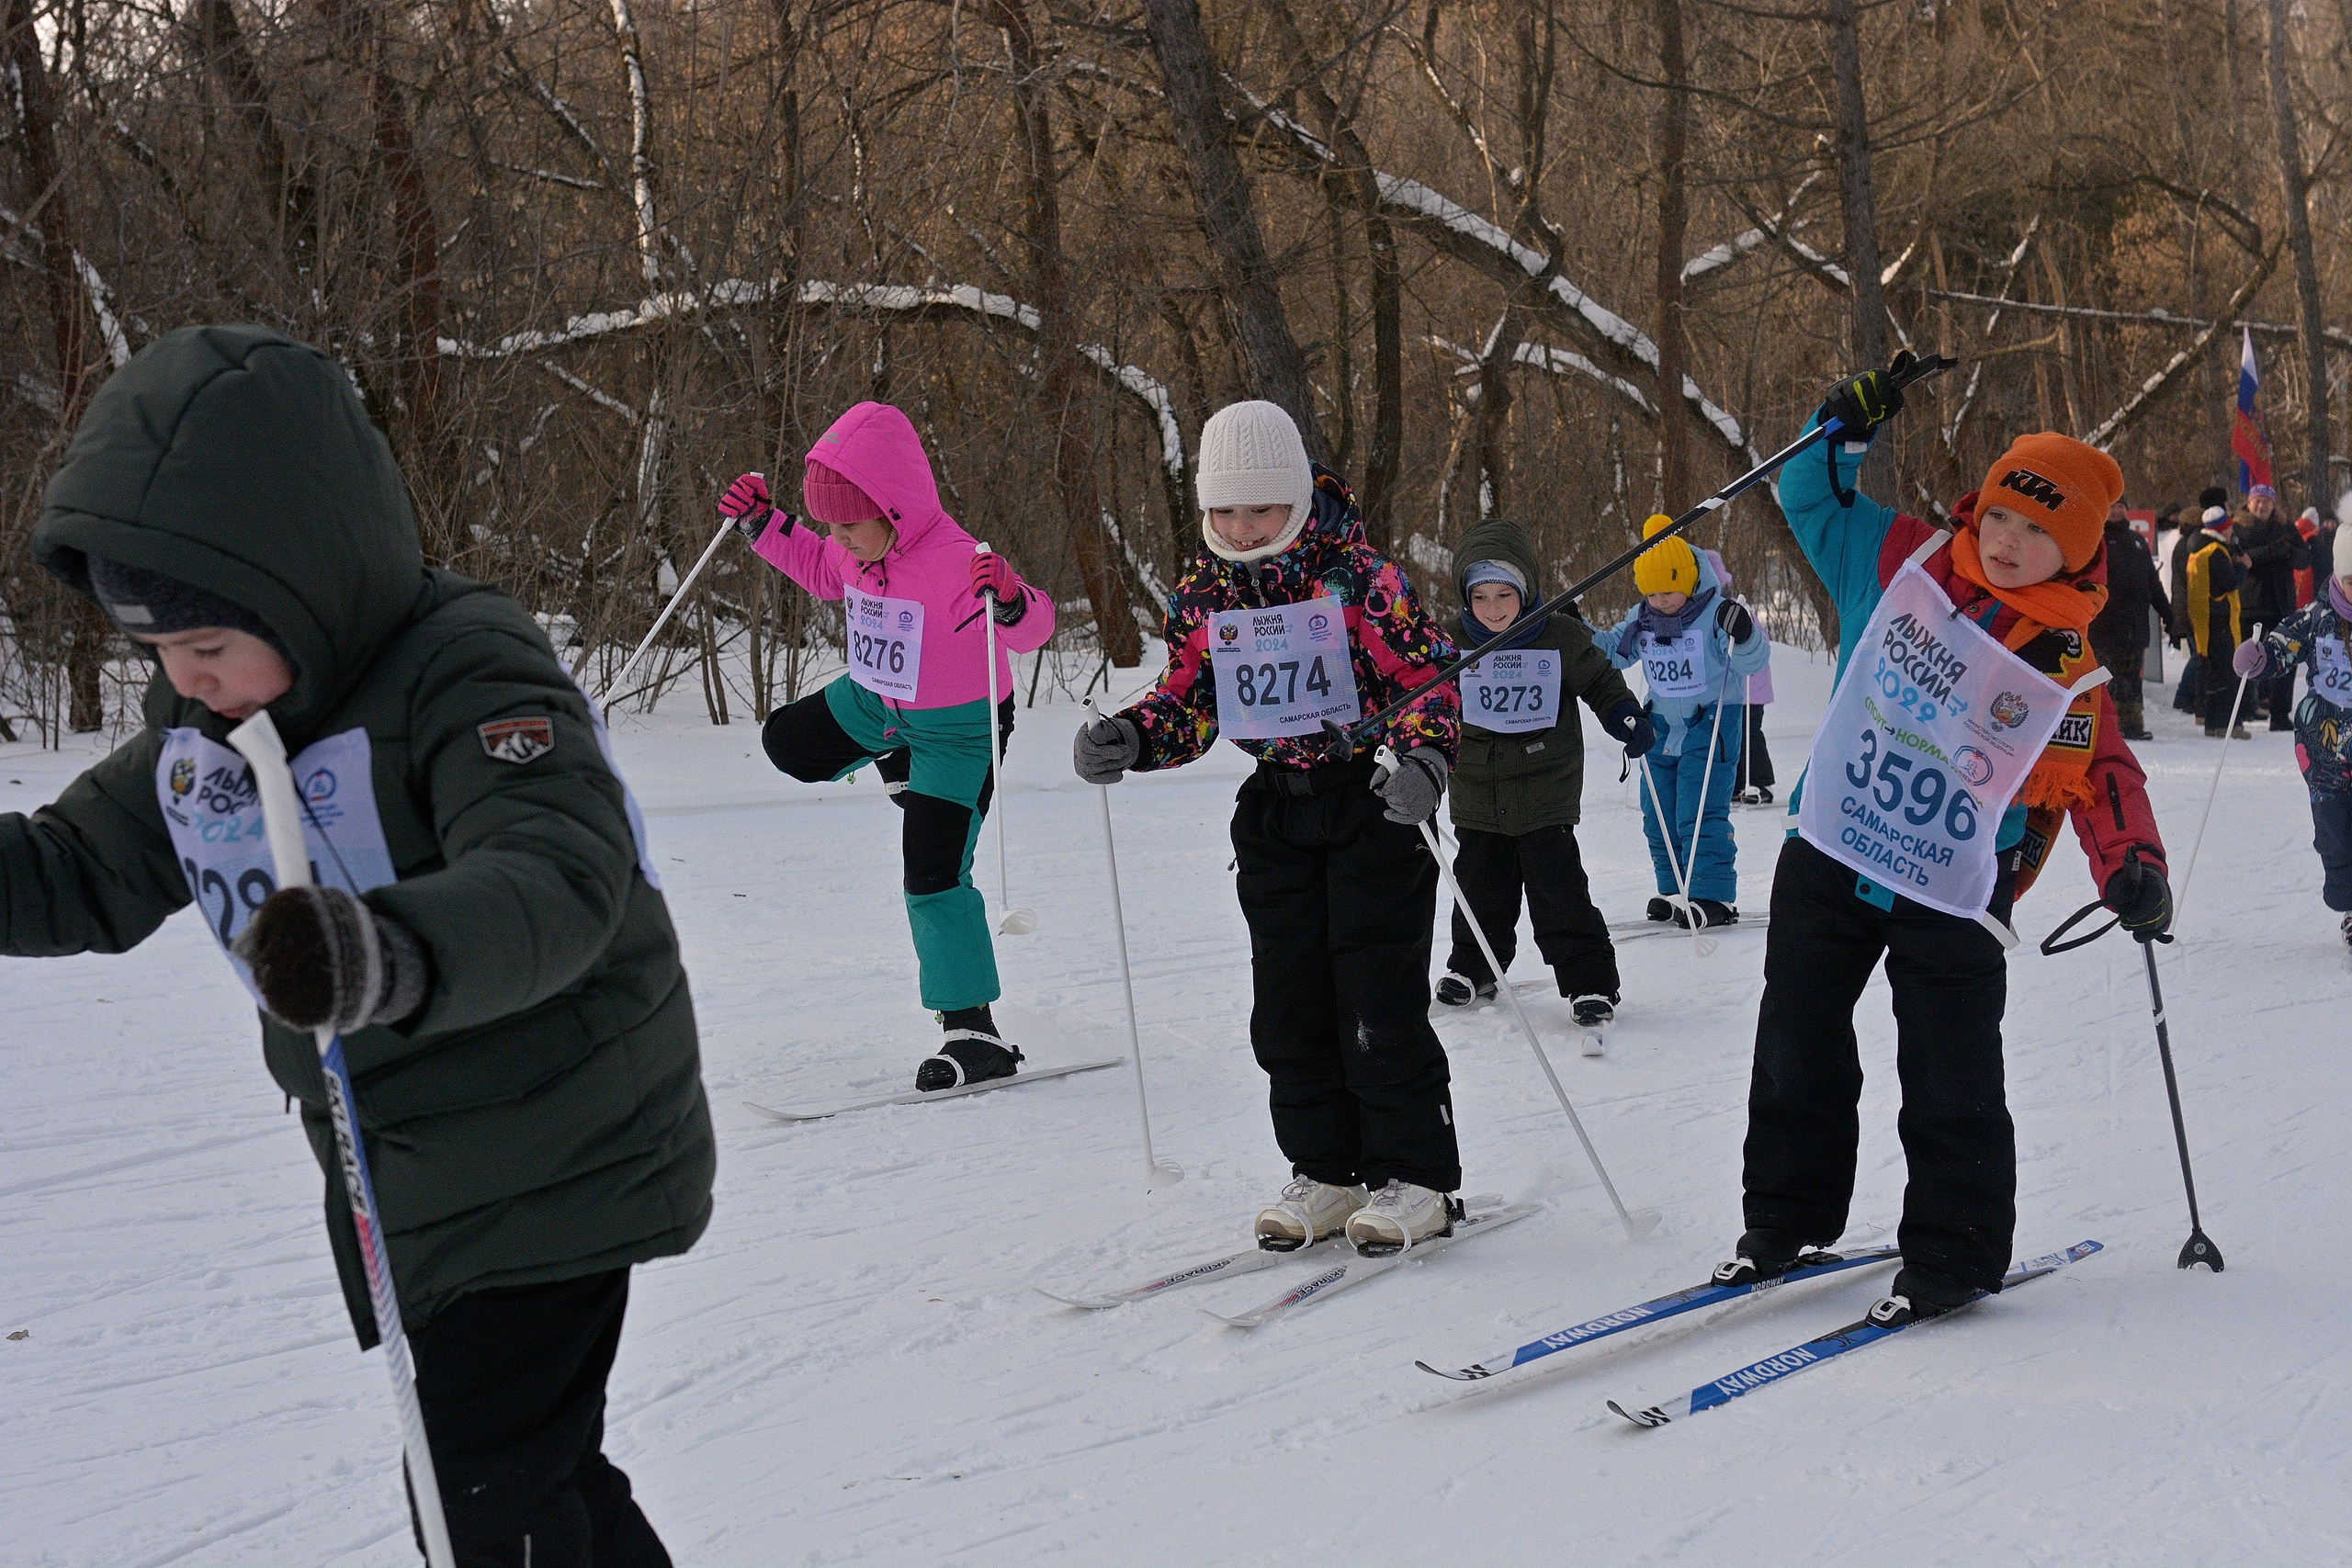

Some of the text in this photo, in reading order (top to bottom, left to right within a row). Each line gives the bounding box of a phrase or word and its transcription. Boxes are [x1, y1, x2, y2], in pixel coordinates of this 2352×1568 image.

[1998, 468, 2066, 512] KTM
[861, 597, 883, 610] ЛЫЖНЯ
[861, 605, 883, 618] РОССИИ
[860, 615, 883, 630] 2024
[1252, 614, 1283, 626] ЛЫЖНЯ
[1254, 625, 1285, 637] РОССИИ
[854, 630, 905, 673] 8276
[1255, 638, 1289, 653] 2024
[1890, 613, 1968, 685] ЛЫЖНЯ
[1236, 655, 1331, 706] 8274
[1493, 671, 1522, 679] 2024
[1648, 659, 1693, 682] 8284
[1882, 628, 1952, 706] РОССИИ
[1478, 685, 1543, 712] 8273
[1873, 656, 1937, 727] 2022
[1279, 703, 1351, 724] САМАРСКАЯ ОБЛАСТЬ
[1864, 696, 1949, 765] СПОРТ НОРМА
[1846, 728, 1979, 841] 3596
[1840, 796, 1954, 867] САМАРСКАЯ
[1840, 827, 1928, 886] ОБЛАСТЬ
[1165, 1268, 1205, 1284] RACE
[1297, 1278, 1328, 1296] RACE
[1751, 1276, 1785, 1292] NORDWAY
[1542, 1305, 1653, 1348] NORDWAY
[1713, 1348, 1818, 1396] NORDWAY
